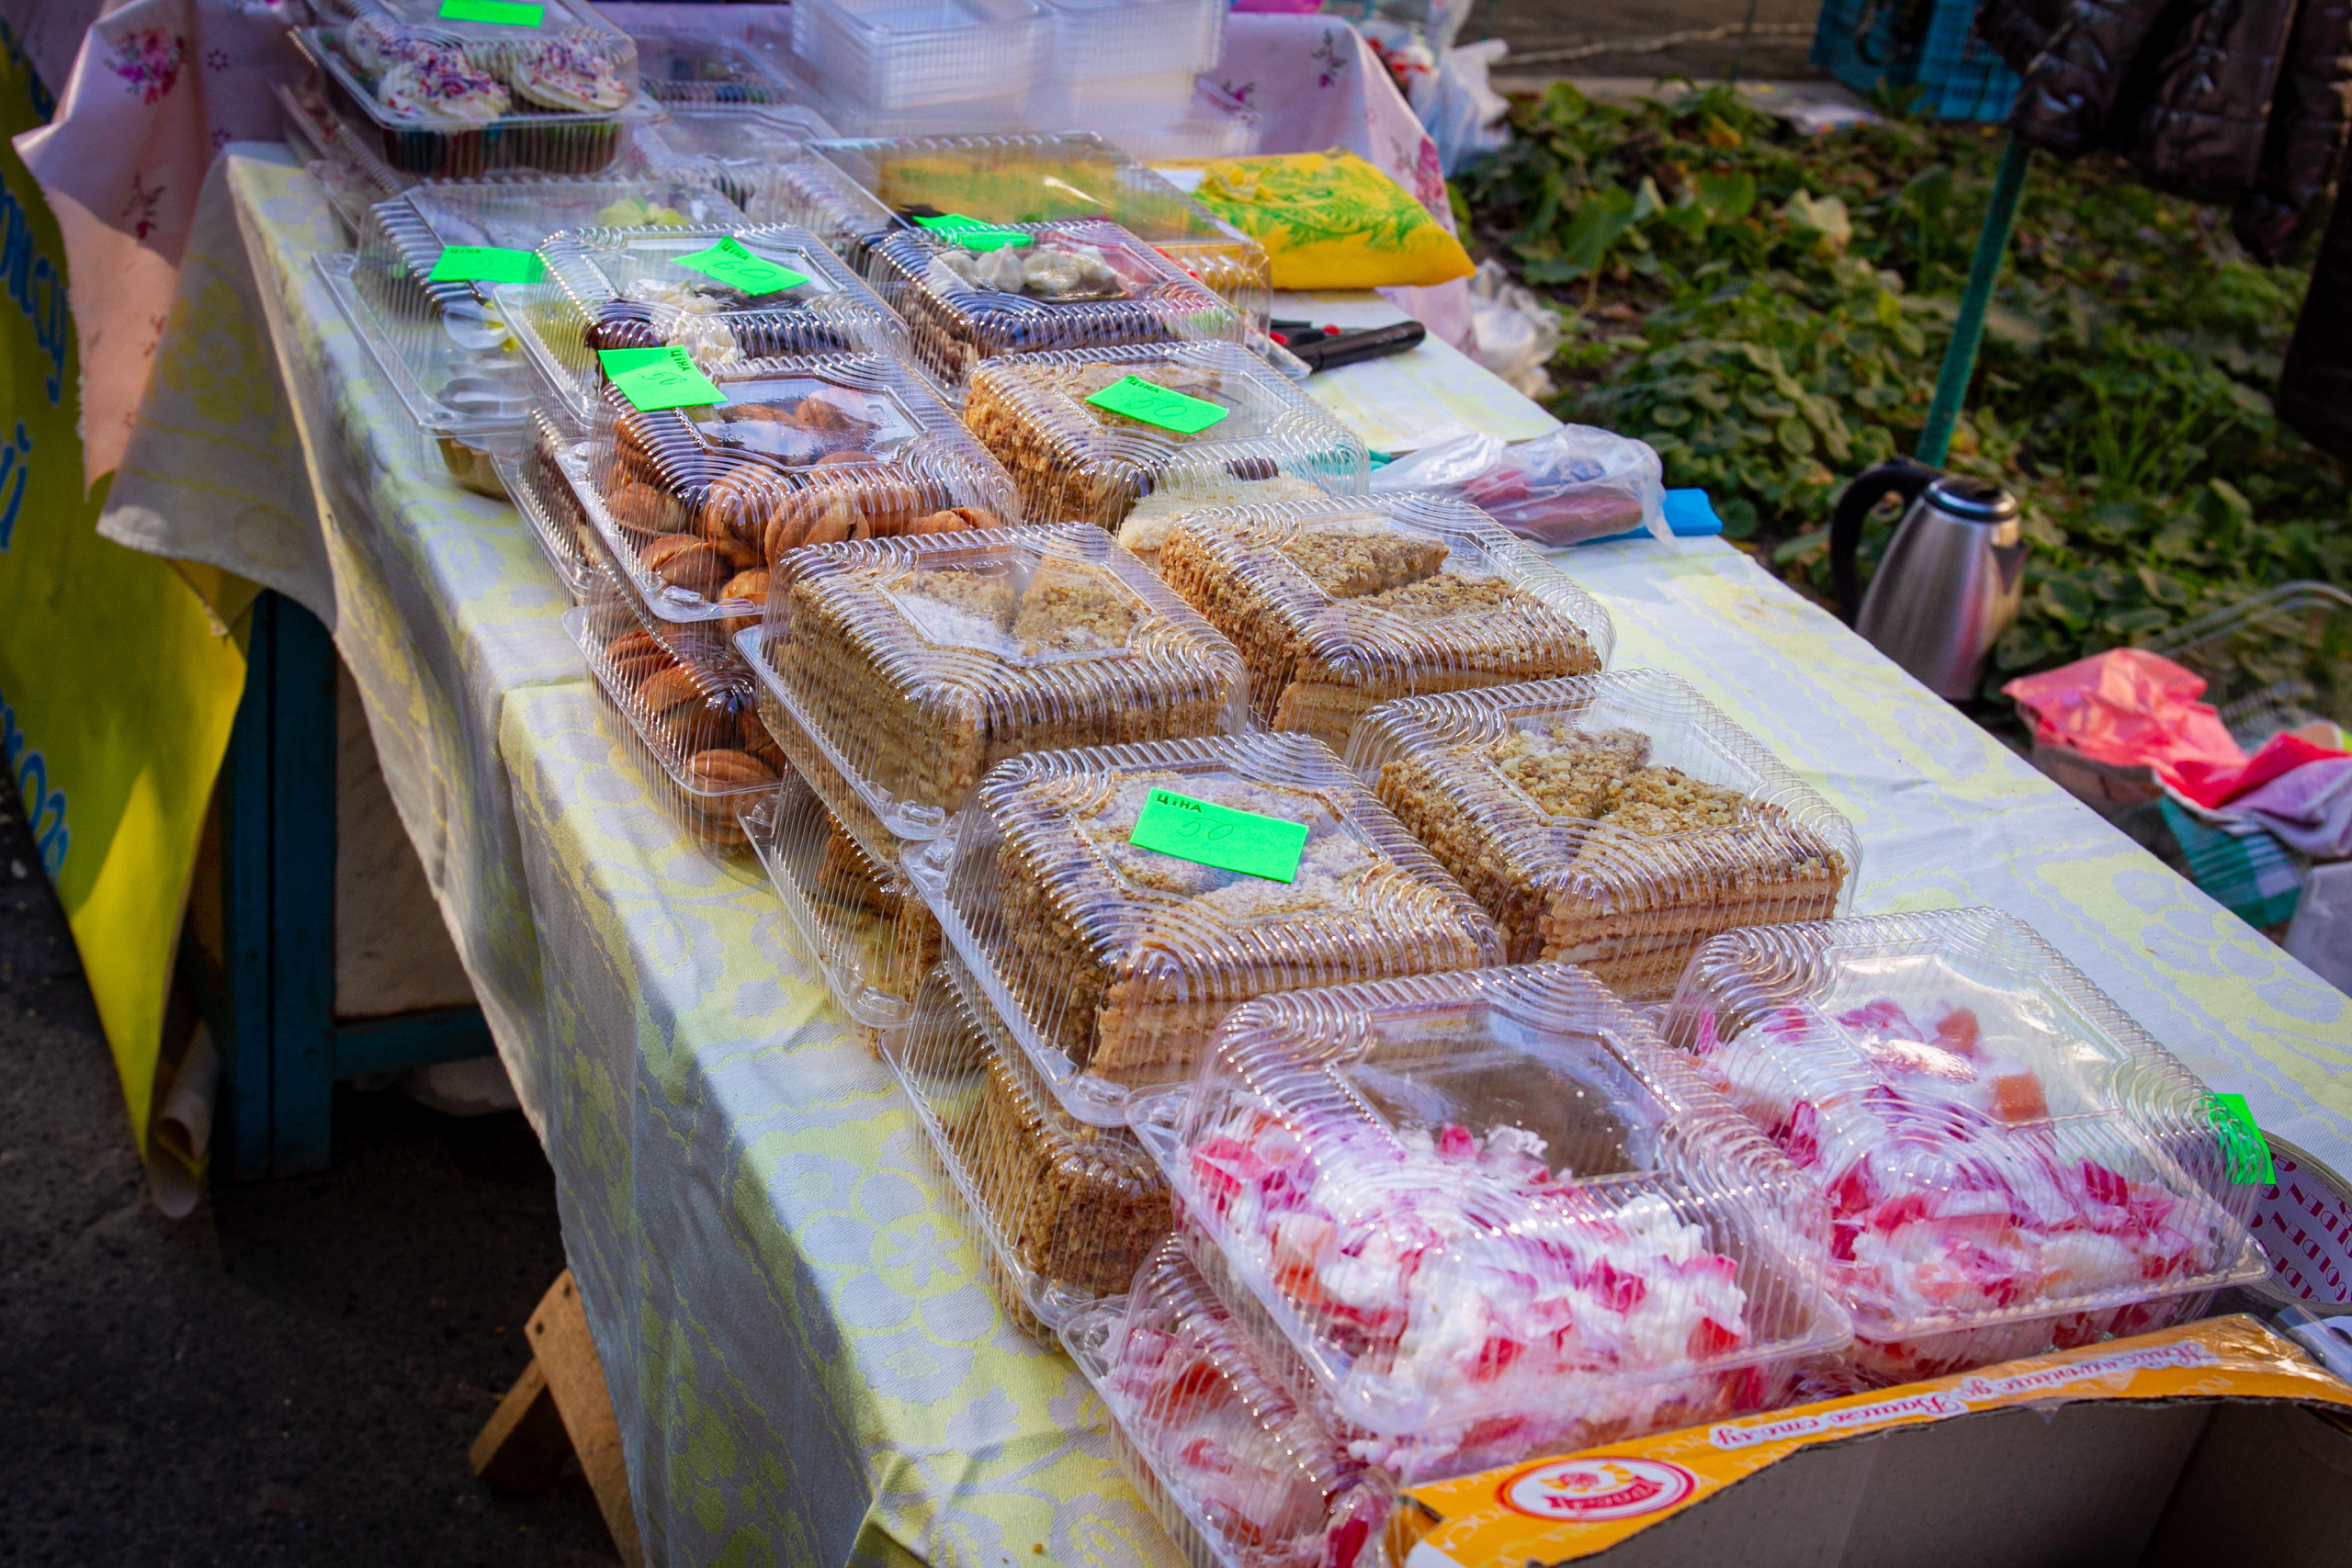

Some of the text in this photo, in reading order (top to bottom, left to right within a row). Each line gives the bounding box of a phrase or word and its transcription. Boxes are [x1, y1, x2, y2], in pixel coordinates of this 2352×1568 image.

[1177, 817, 1234, 841] 50
[2268, 1211, 2347, 1302] GOLDEN
[1961, 1380, 1993, 1397] до
[1828, 1394, 1961, 1424] Вашого
[1716, 1417, 1819, 1446] столу
